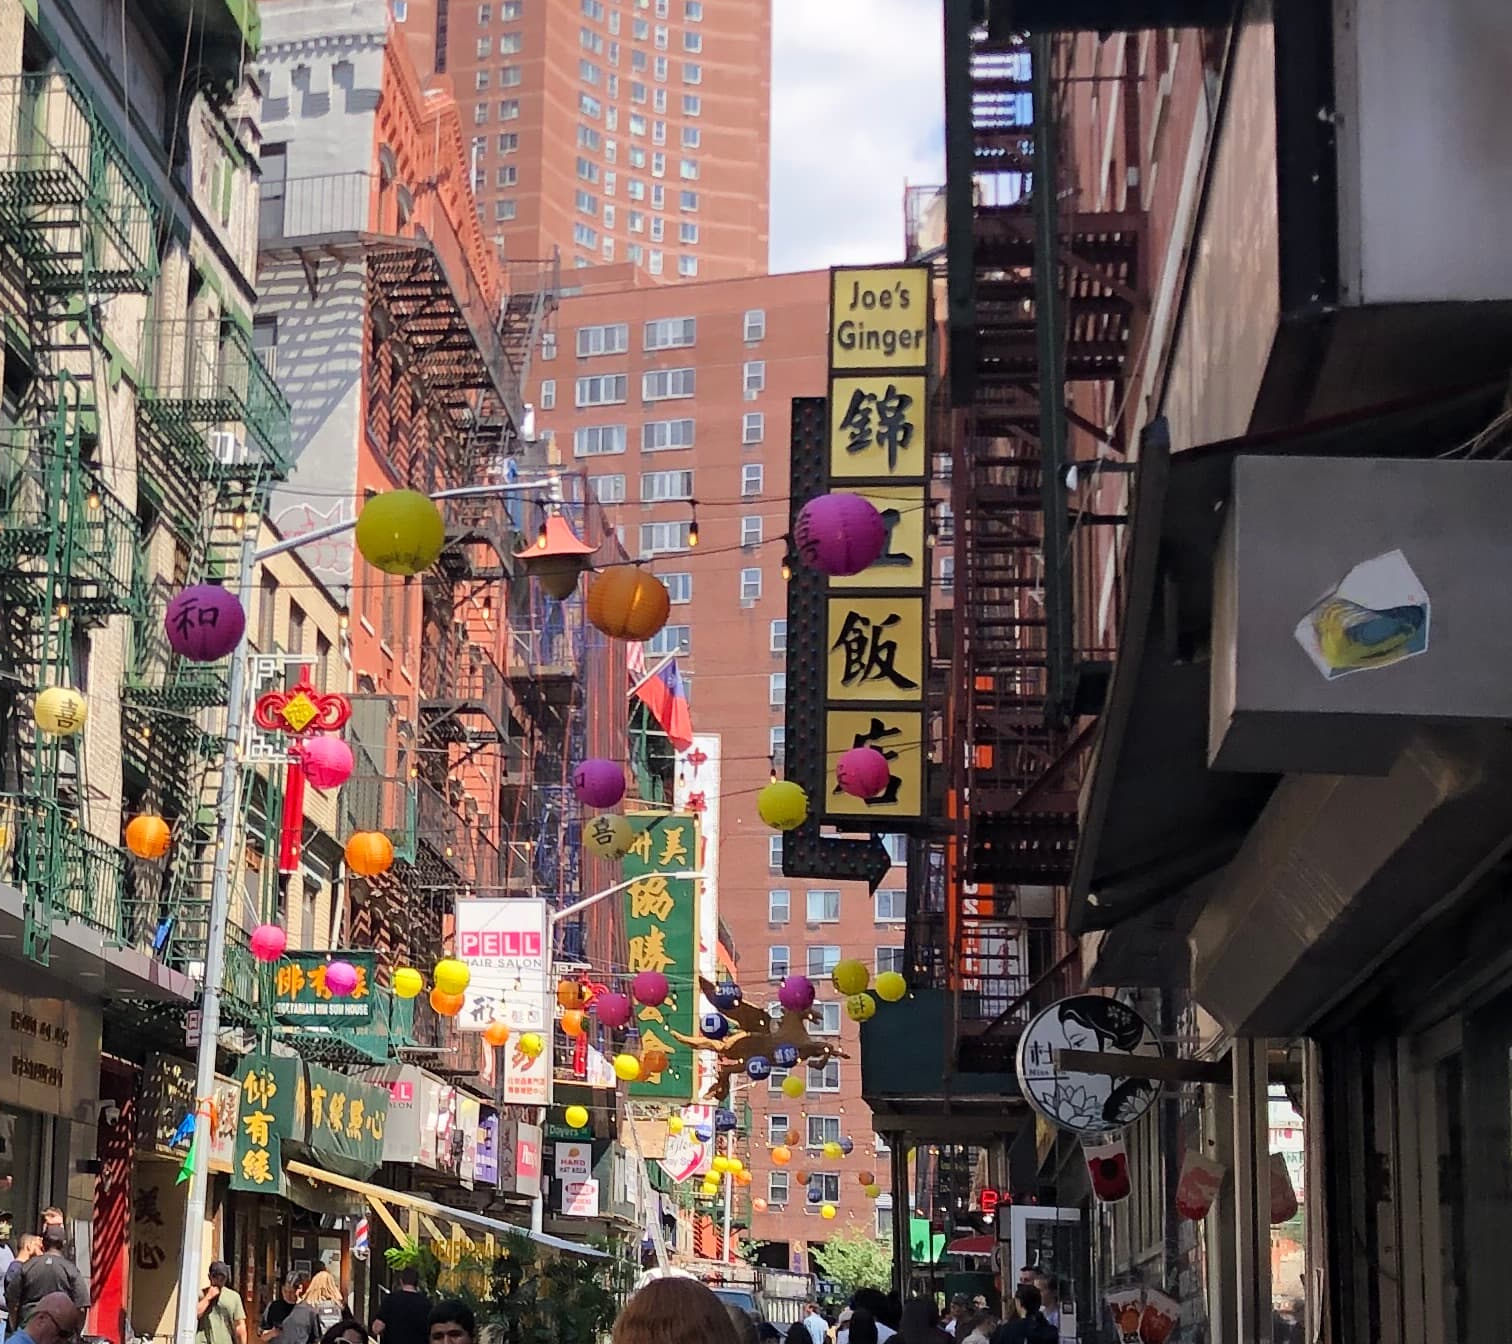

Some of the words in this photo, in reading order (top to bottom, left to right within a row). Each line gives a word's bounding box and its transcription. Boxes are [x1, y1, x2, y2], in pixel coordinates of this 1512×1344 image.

[849, 280, 910, 311] Joe's
[837, 320, 924, 358] Ginger
[172, 598, 219, 640] 和
[462, 933, 541, 956] PELL
[497, 958, 542, 969] SALON
[345, 1002, 369, 1016] HOUSE
[241, 1068, 278, 1185] 佛有緣
[561, 1158, 586, 1166] HARD
